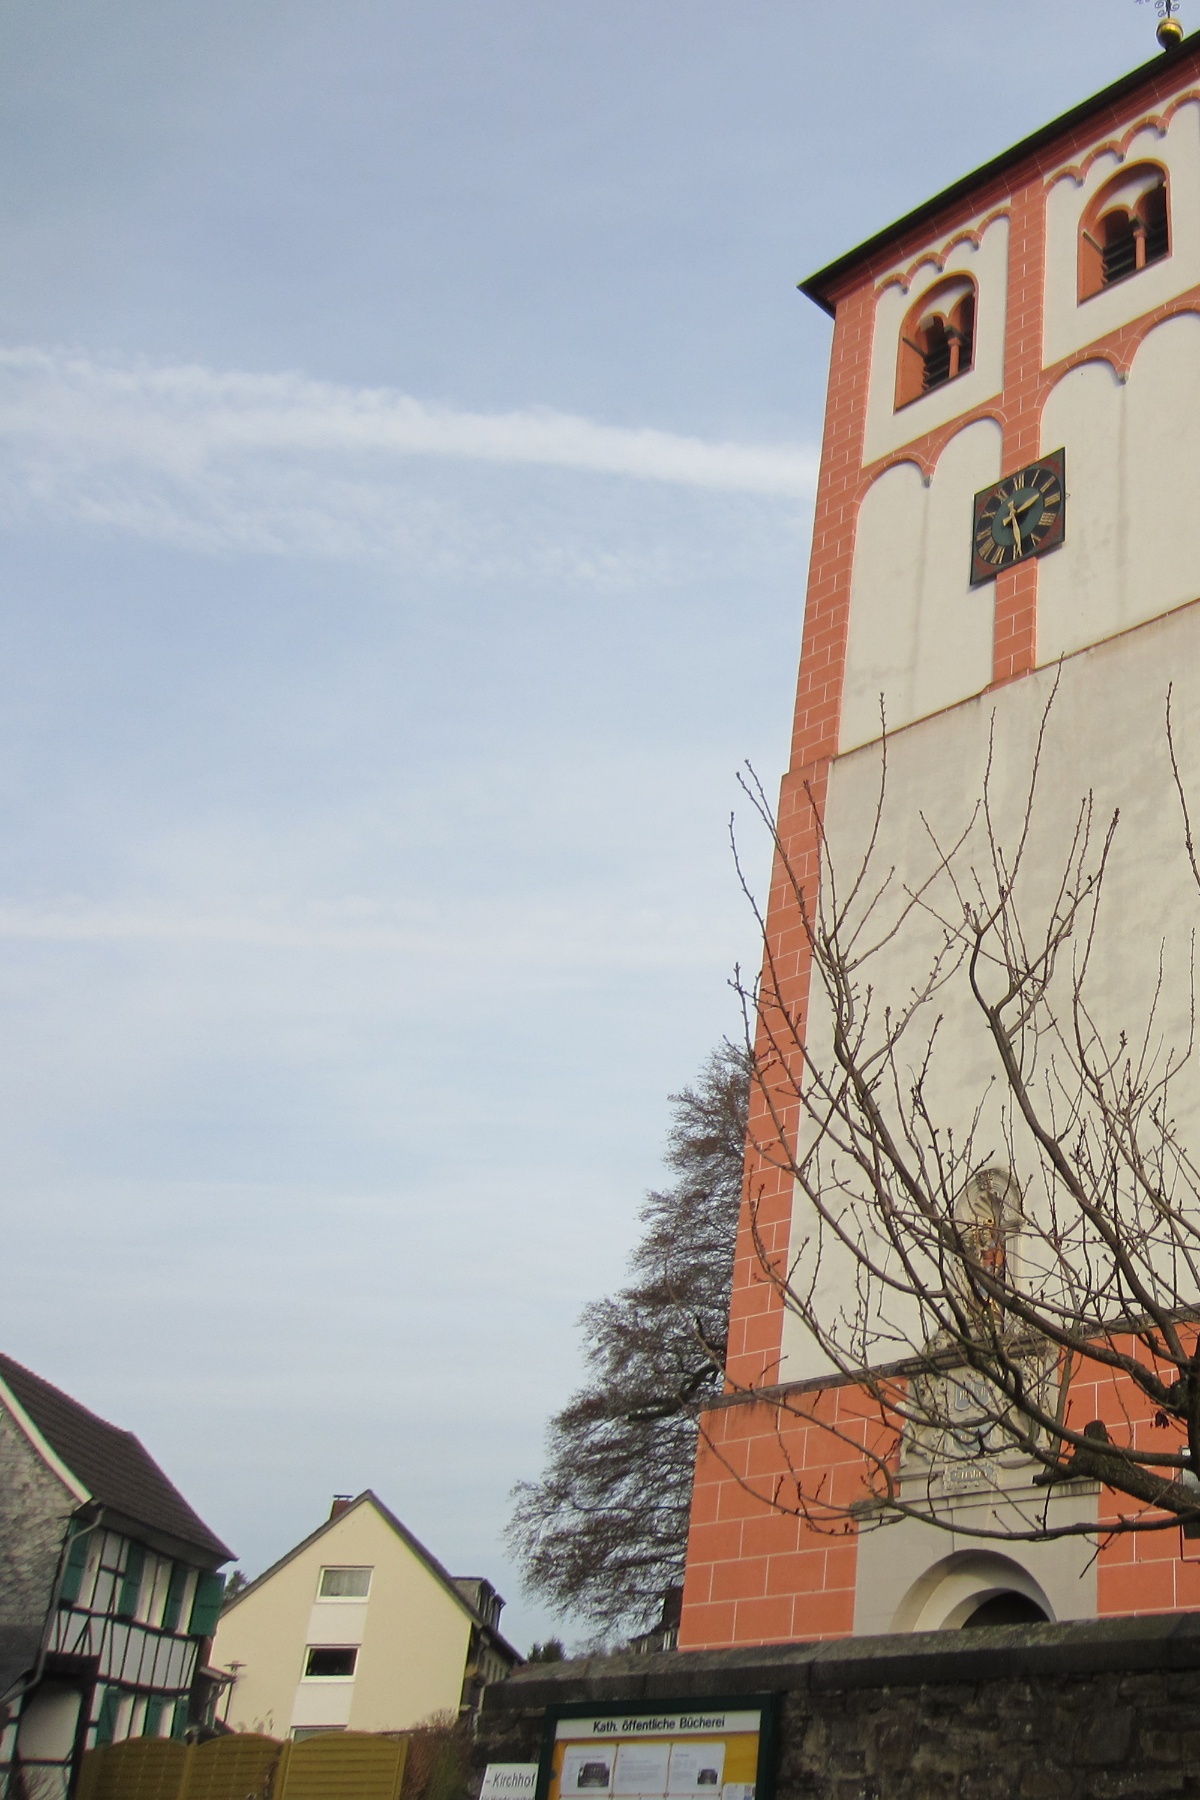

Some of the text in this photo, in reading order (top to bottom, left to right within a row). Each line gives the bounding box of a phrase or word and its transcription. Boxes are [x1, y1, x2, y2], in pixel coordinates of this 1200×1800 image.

[592, 1715, 726, 1733] Kath. öffentliche Bücherei
[492, 1771, 537, 1788] Kirchhof
